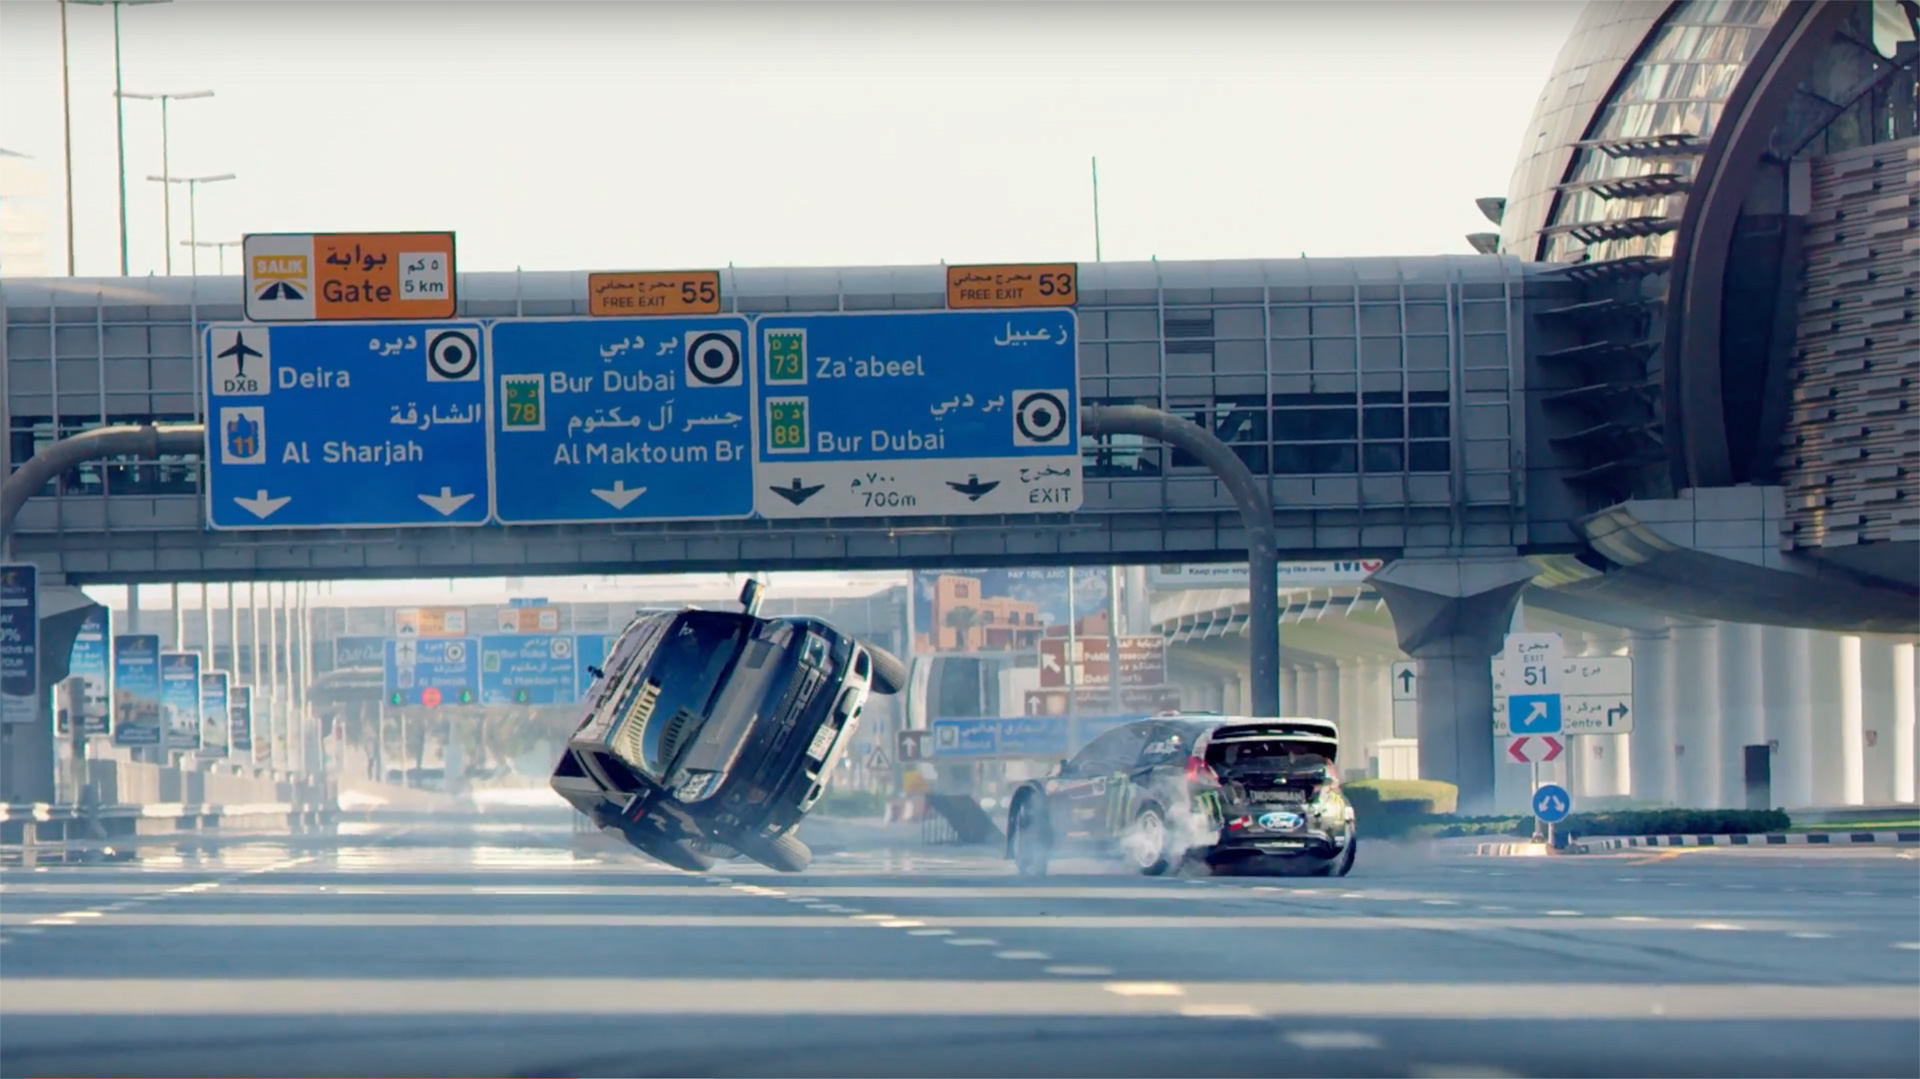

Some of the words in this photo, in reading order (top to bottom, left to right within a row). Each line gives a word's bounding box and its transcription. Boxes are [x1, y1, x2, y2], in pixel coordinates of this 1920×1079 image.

[256, 260, 303, 274] SALIK
[326, 243, 387, 271] بوابة
[407, 258, 426, 275] كم
[323, 278, 392, 303] Gate
[404, 281, 414, 293] 5
[419, 279, 444, 293] km
[681, 281, 716, 304] 55
[959, 289, 991, 300] FREE
[995, 288, 1023, 300] EXIT
[1038, 273, 1073, 295] 53
[602, 297, 634, 307] FREE
[638, 296, 666, 307] EXIT
[994, 322, 1068, 346] زعبيل
[600, 336, 645, 362] دبي
[656, 338, 678, 355] بر
[773, 354, 799, 375] 73
[223, 380, 259, 392] DXB
[277, 366, 350, 389] Deira
[550, 371, 593, 393] Bur
[603, 370, 675, 392] Dubai
[509, 403, 537, 422] 78
[930, 393, 974, 420] دبي
[982, 396, 1005, 412] بر
[389, 402, 482, 430] الشارقة
[567, 406, 641, 438] مكتوم
[648, 399, 674, 431] آل
[682, 411, 743, 432] جسر
[774, 424, 800, 445] 88
[817, 432, 862, 453] Bur
[871, 429, 945, 452] Dubai
[233, 436, 254, 455] 11
[281, 441, 310, 464] Al
[322, 440, 424, 466] Sharjah
[554, 443, 580, 464] Al
[586, 442, 708, 465] Maktoum
[715, 440, 745, 461] Br
[1029, 487, 1071, 504] EXIT
[1523, 654, 1544, 663] EXIT
[1523, 666, 1547, 685] 51
